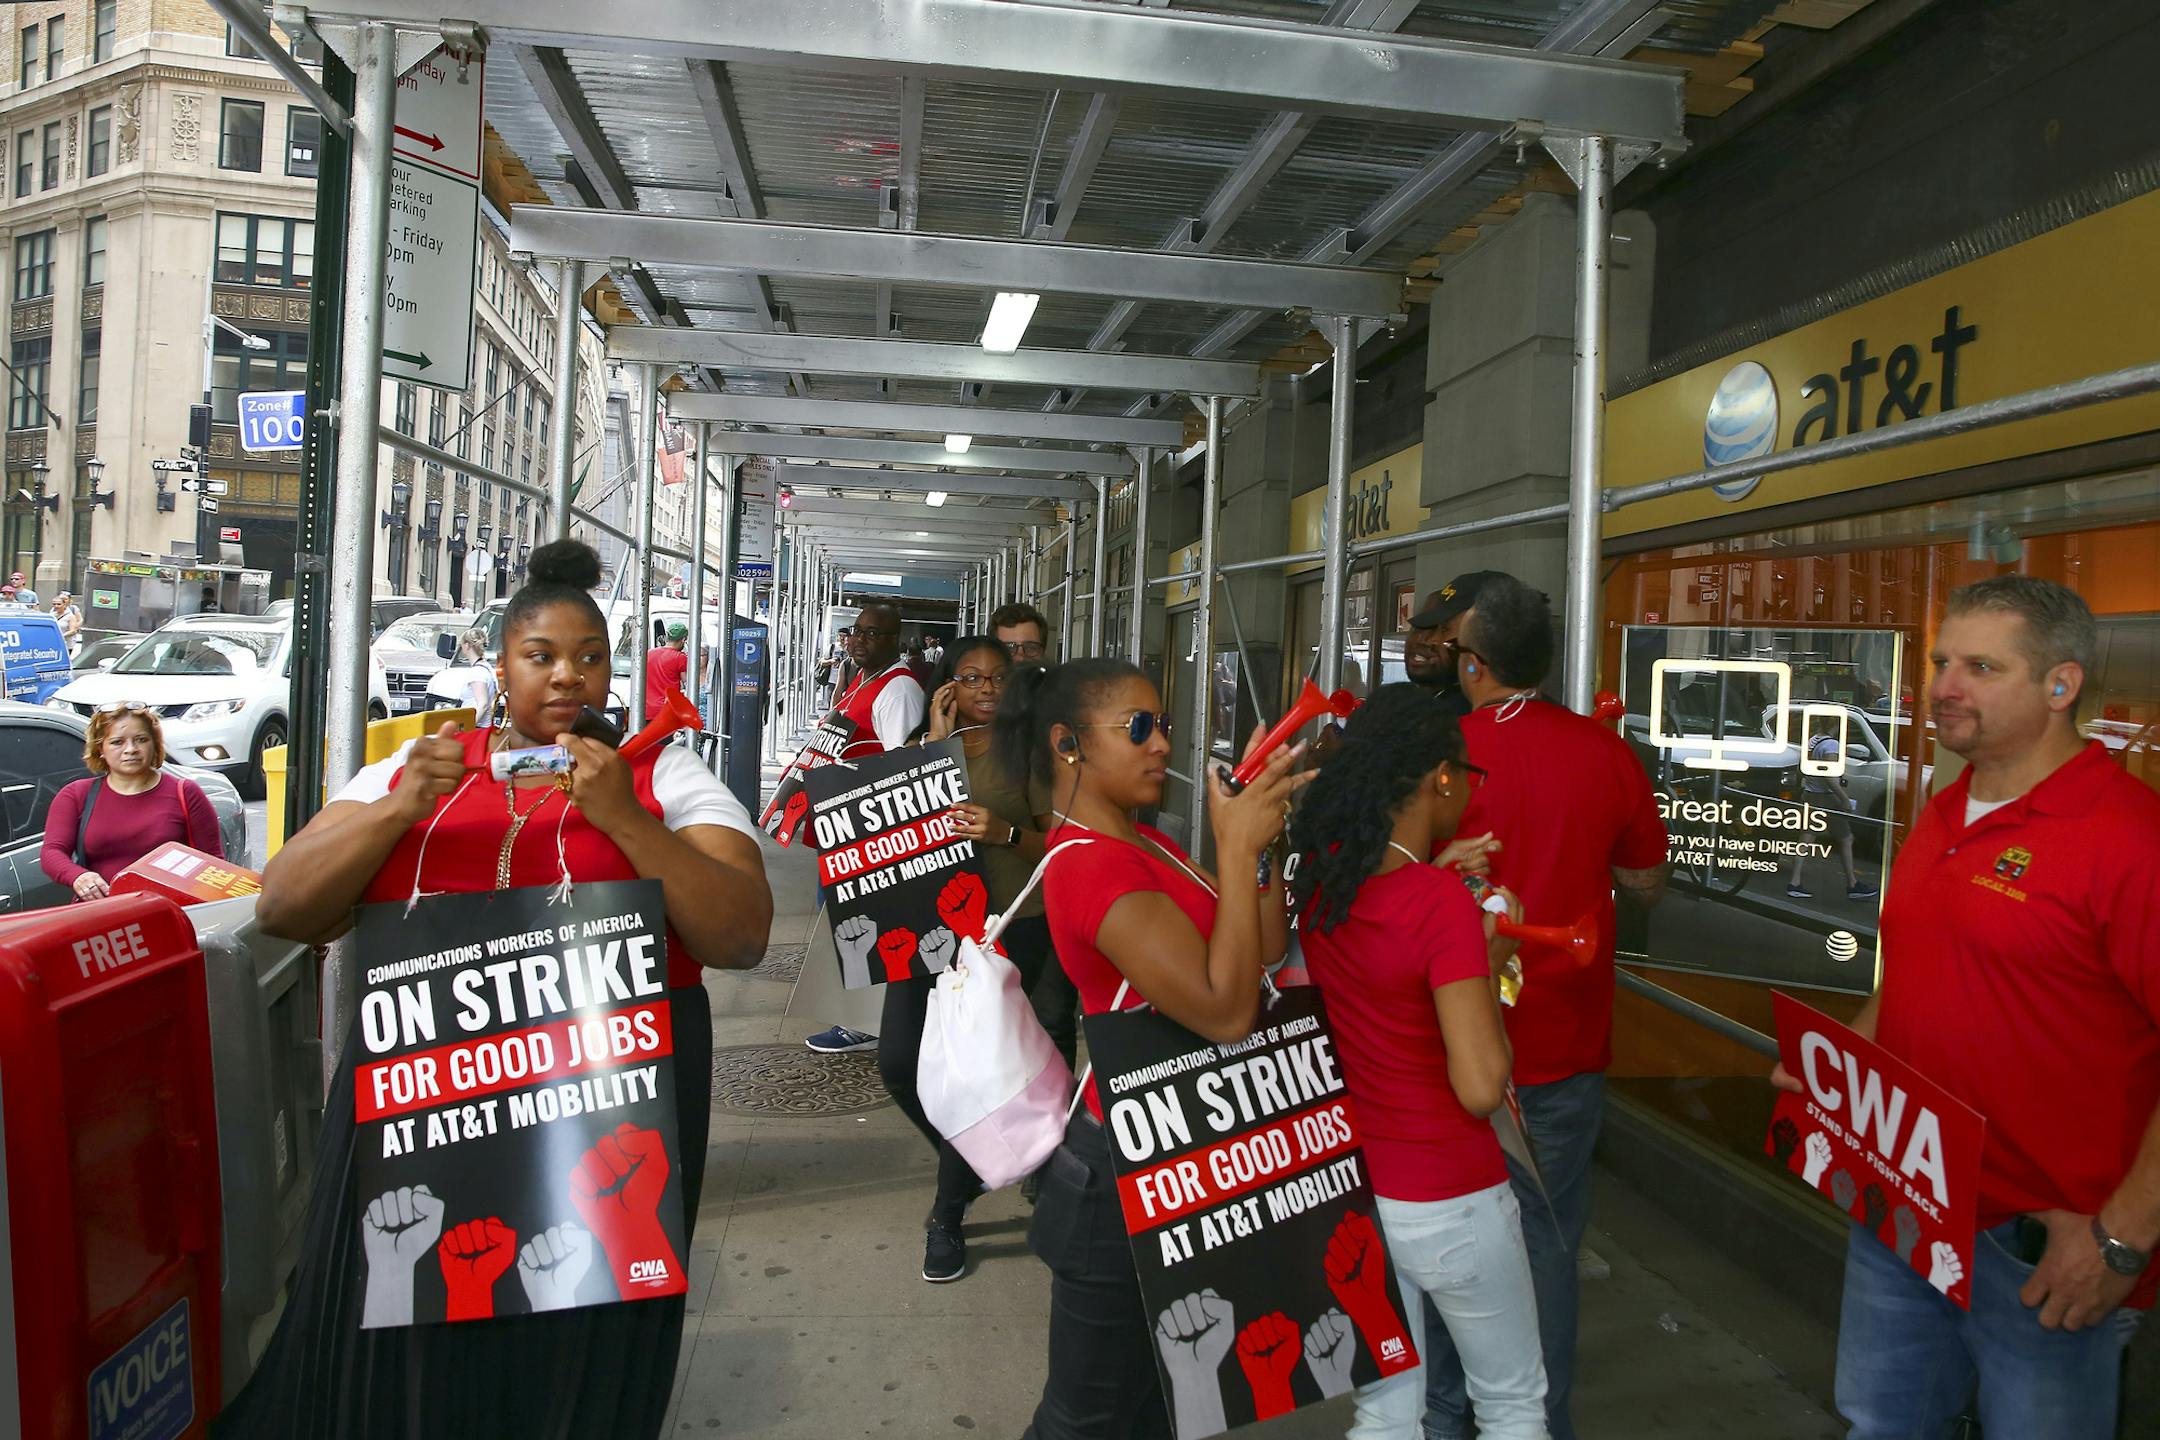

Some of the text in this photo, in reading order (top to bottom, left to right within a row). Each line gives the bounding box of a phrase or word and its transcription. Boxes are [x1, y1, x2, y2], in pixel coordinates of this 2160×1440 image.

[391, 167, 412, 183] our
[391, 182, 433, 205] etered
[390, 199, 426, 221] arking
[403, 227, 444, 255] Friday
[1792, 305, 1978, 448] at&t
[247, 400, 292, 412] Zone#
[744, 642, 756, 661] P
[814, 756, 955, 813] COMMUNICATIONS WORKERS OF AMERICA
[814, 768, 969, 849] ON STRIKE
[1653, 792, 1828, 832] Great deals
[825, 848, 864, 879] FOR
[866, 827, 920, 865] GOOD
[836, 839, 976, 904] AT AT&T MOBILITY
[1674, 852, 1715, 867] AT&T
[1717, 854, 1778, 873] wireless
[1687, 835, 1715, 850] you
[1718, 835, 1755, 852] have
[1758, 838, 1832, 859] DIRECTV
[194, 865, 237, 890] FREE
[71, 923, 150, 980] FREE
[367, 912, 644, 985] COMMUNICATIONS WORKERS OF AMERICA
[361, 934, 663, 1053] ON STRIKE
[372, 1010, 660, 1110] FOR GOOD JOBS
[1109, 1047, 1217, 1094] COMMUNICATIONS
[1266, 1026, 1280, 1043] OF
[1281, 1015, 1320, 1040] AMERICA
[382, 1065, 659, 1159] AT AT&T MOBILITY
[1109, 1035, 1345, 1163] ON STRIKE
[1800, 1031, 1949, 1209] CWA
[1135, 1105, 1352, 1219] FOR GOOD JOBS
[1806, 1101, 1842, 1137] STAND
[1867, 1151, 1901, 1188] FIGHT
[1904, 1183, 1943, 1224] BACK.
[1158, 1157, 1362, 1267] AT AT&T MOBILITY
[630, 1259, 667, 1278] CWA
[101, 1314, 186, 1424] VOICE
[1381, 1336, 1404, 1356] CWA
